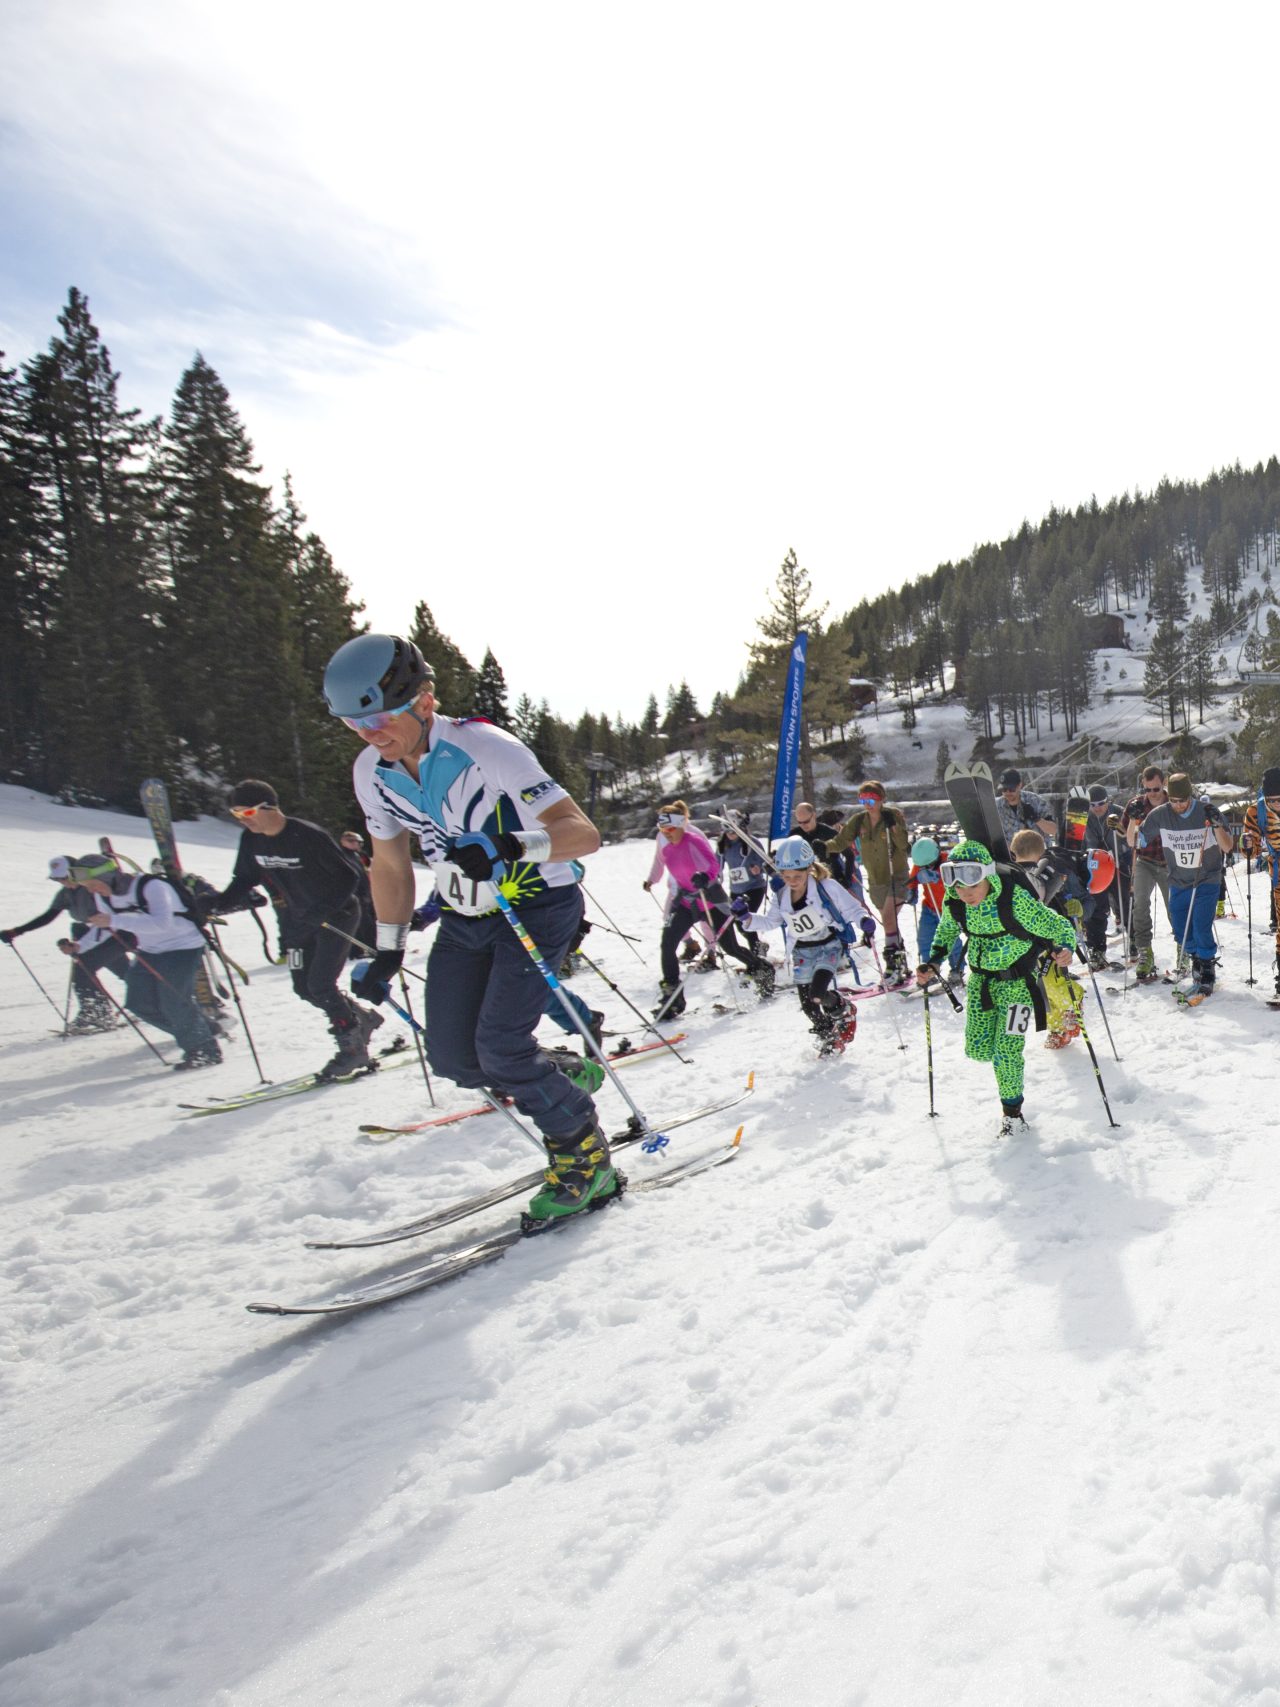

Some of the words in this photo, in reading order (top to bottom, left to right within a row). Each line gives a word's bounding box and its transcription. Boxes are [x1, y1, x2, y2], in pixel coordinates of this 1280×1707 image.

[781, 785, 790, 831] TAHOE
[790, 666, 800, 716] SPORTS
[1185, 833, 1206, 842] Sierr
[1180, 852, 1195, 865] 57
[1008, 1004, 1031, 1034] 13
